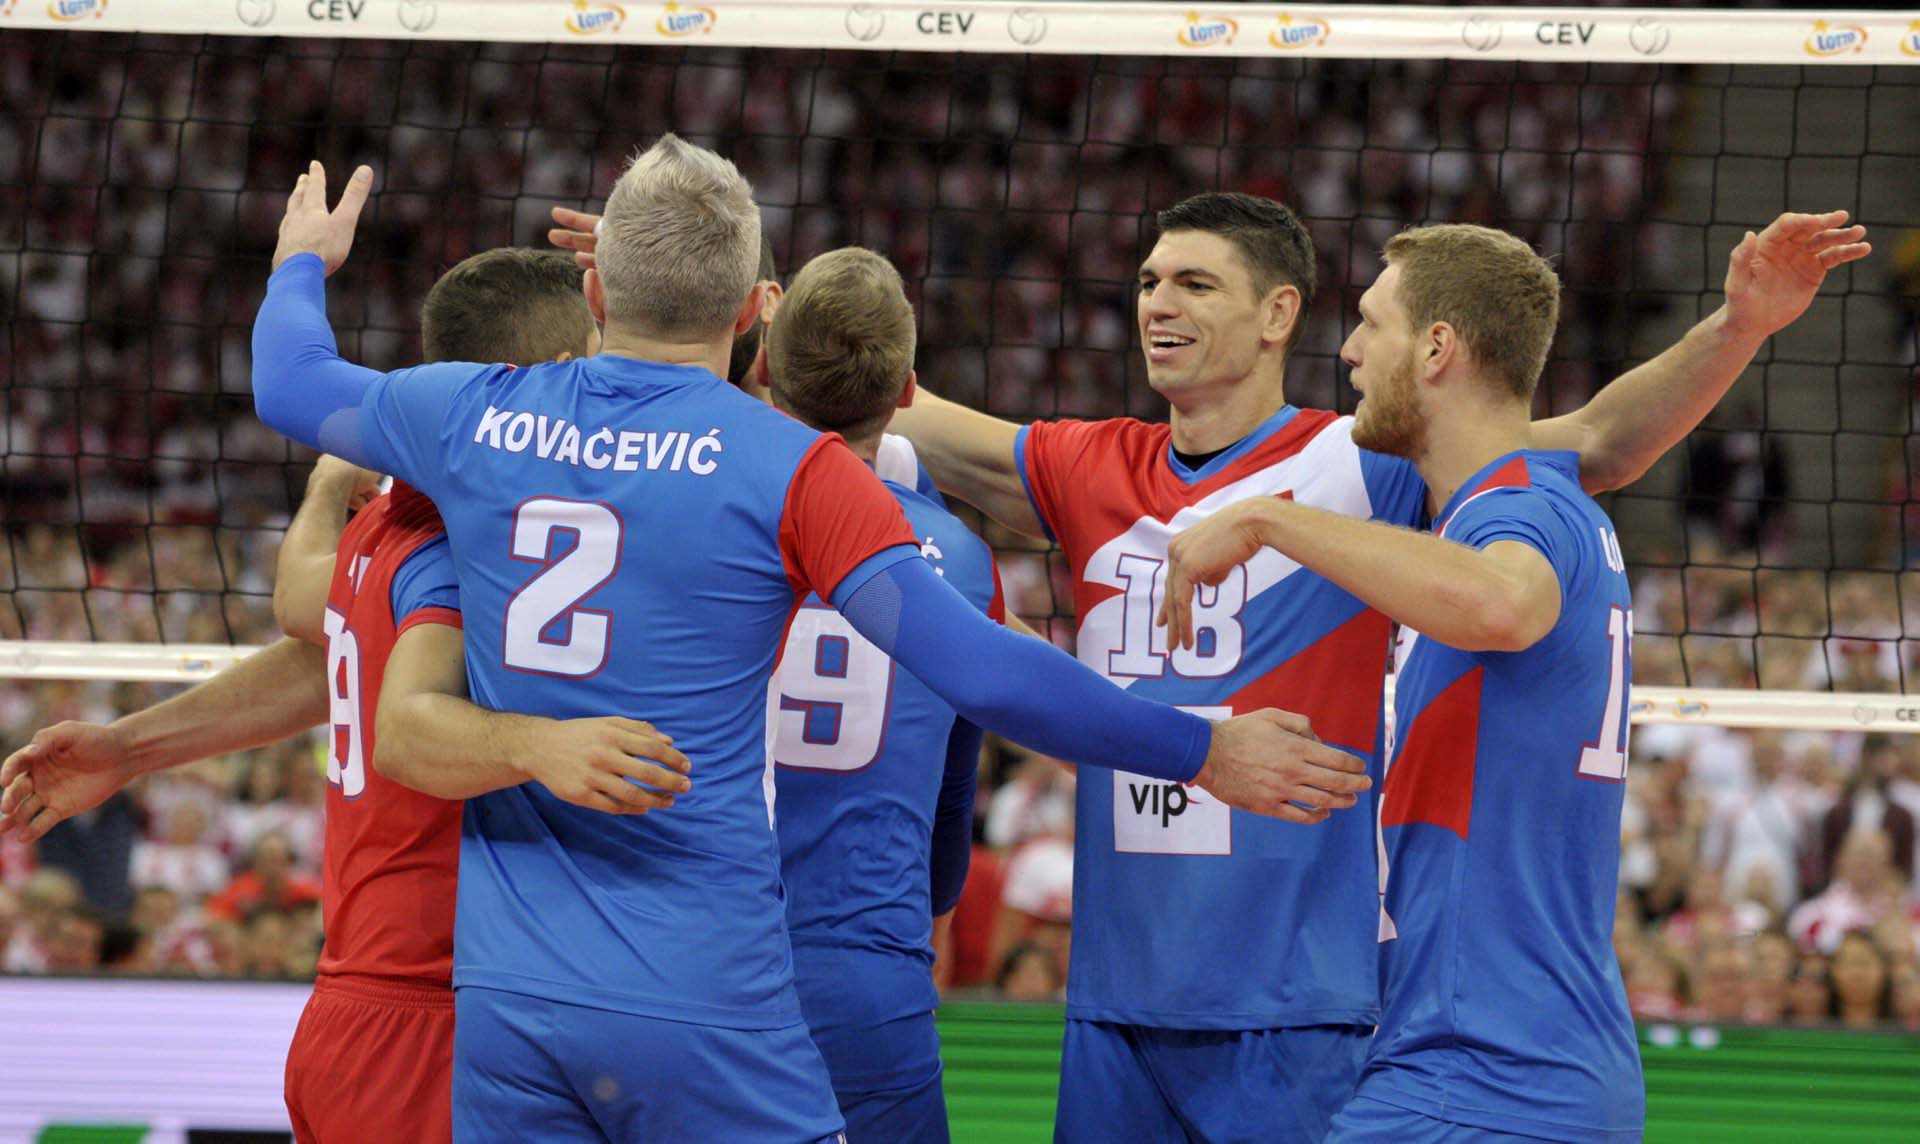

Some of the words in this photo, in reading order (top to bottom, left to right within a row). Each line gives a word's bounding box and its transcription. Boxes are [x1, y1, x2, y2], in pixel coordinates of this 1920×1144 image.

[308, 0, 365, 20] CEV
[917, 11, 975, 35] CEV
[1536, 22, 1595, 45] CEV
[502, 495, 625, 679] 2
[1107, 552, 1248, 680] 18
[770, 602, 895, 773] 9
[1129, 782, 1188, 828] vip
